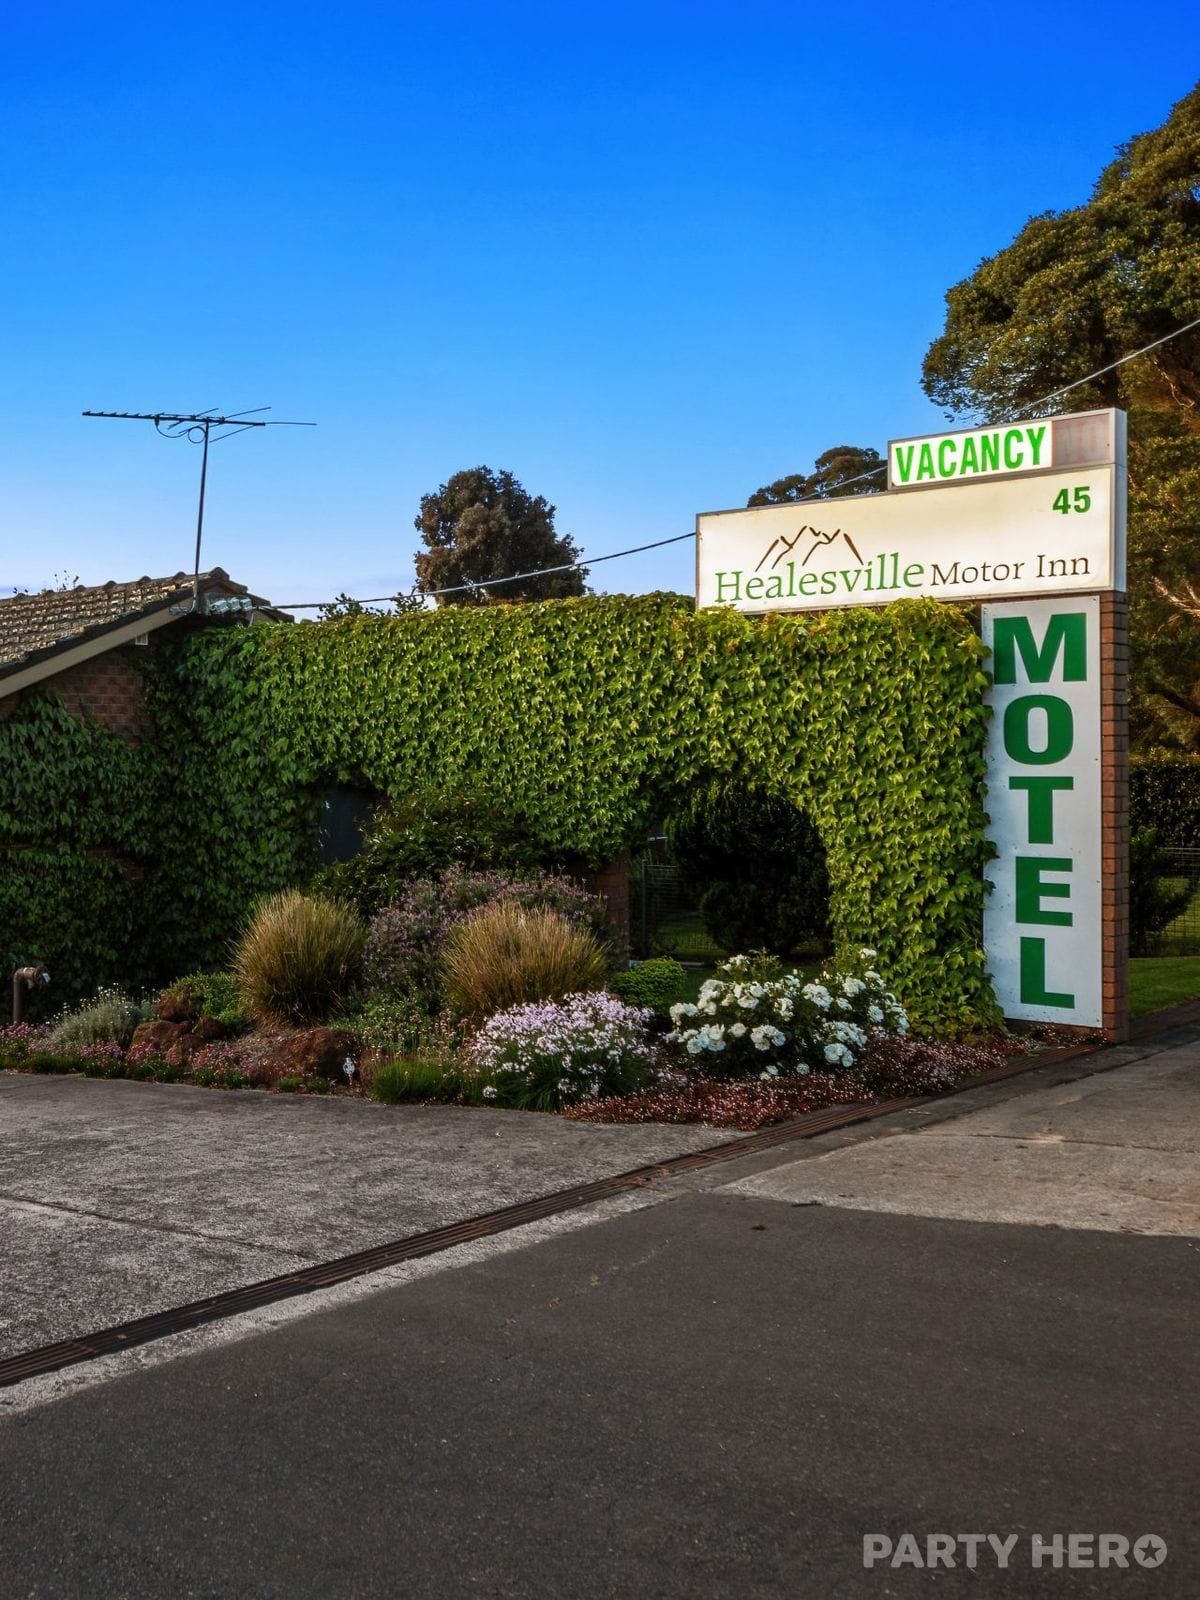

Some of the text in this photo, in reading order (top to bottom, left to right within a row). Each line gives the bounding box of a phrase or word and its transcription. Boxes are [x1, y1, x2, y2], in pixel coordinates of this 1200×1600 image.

[895, 426, 1046, 483] VACANCY
[1052, 486, 1091, 515] 45
[714, 552, 1091, 603] Healesville Motor Inn
[993, 612, 1088, 1009] MOTEL
